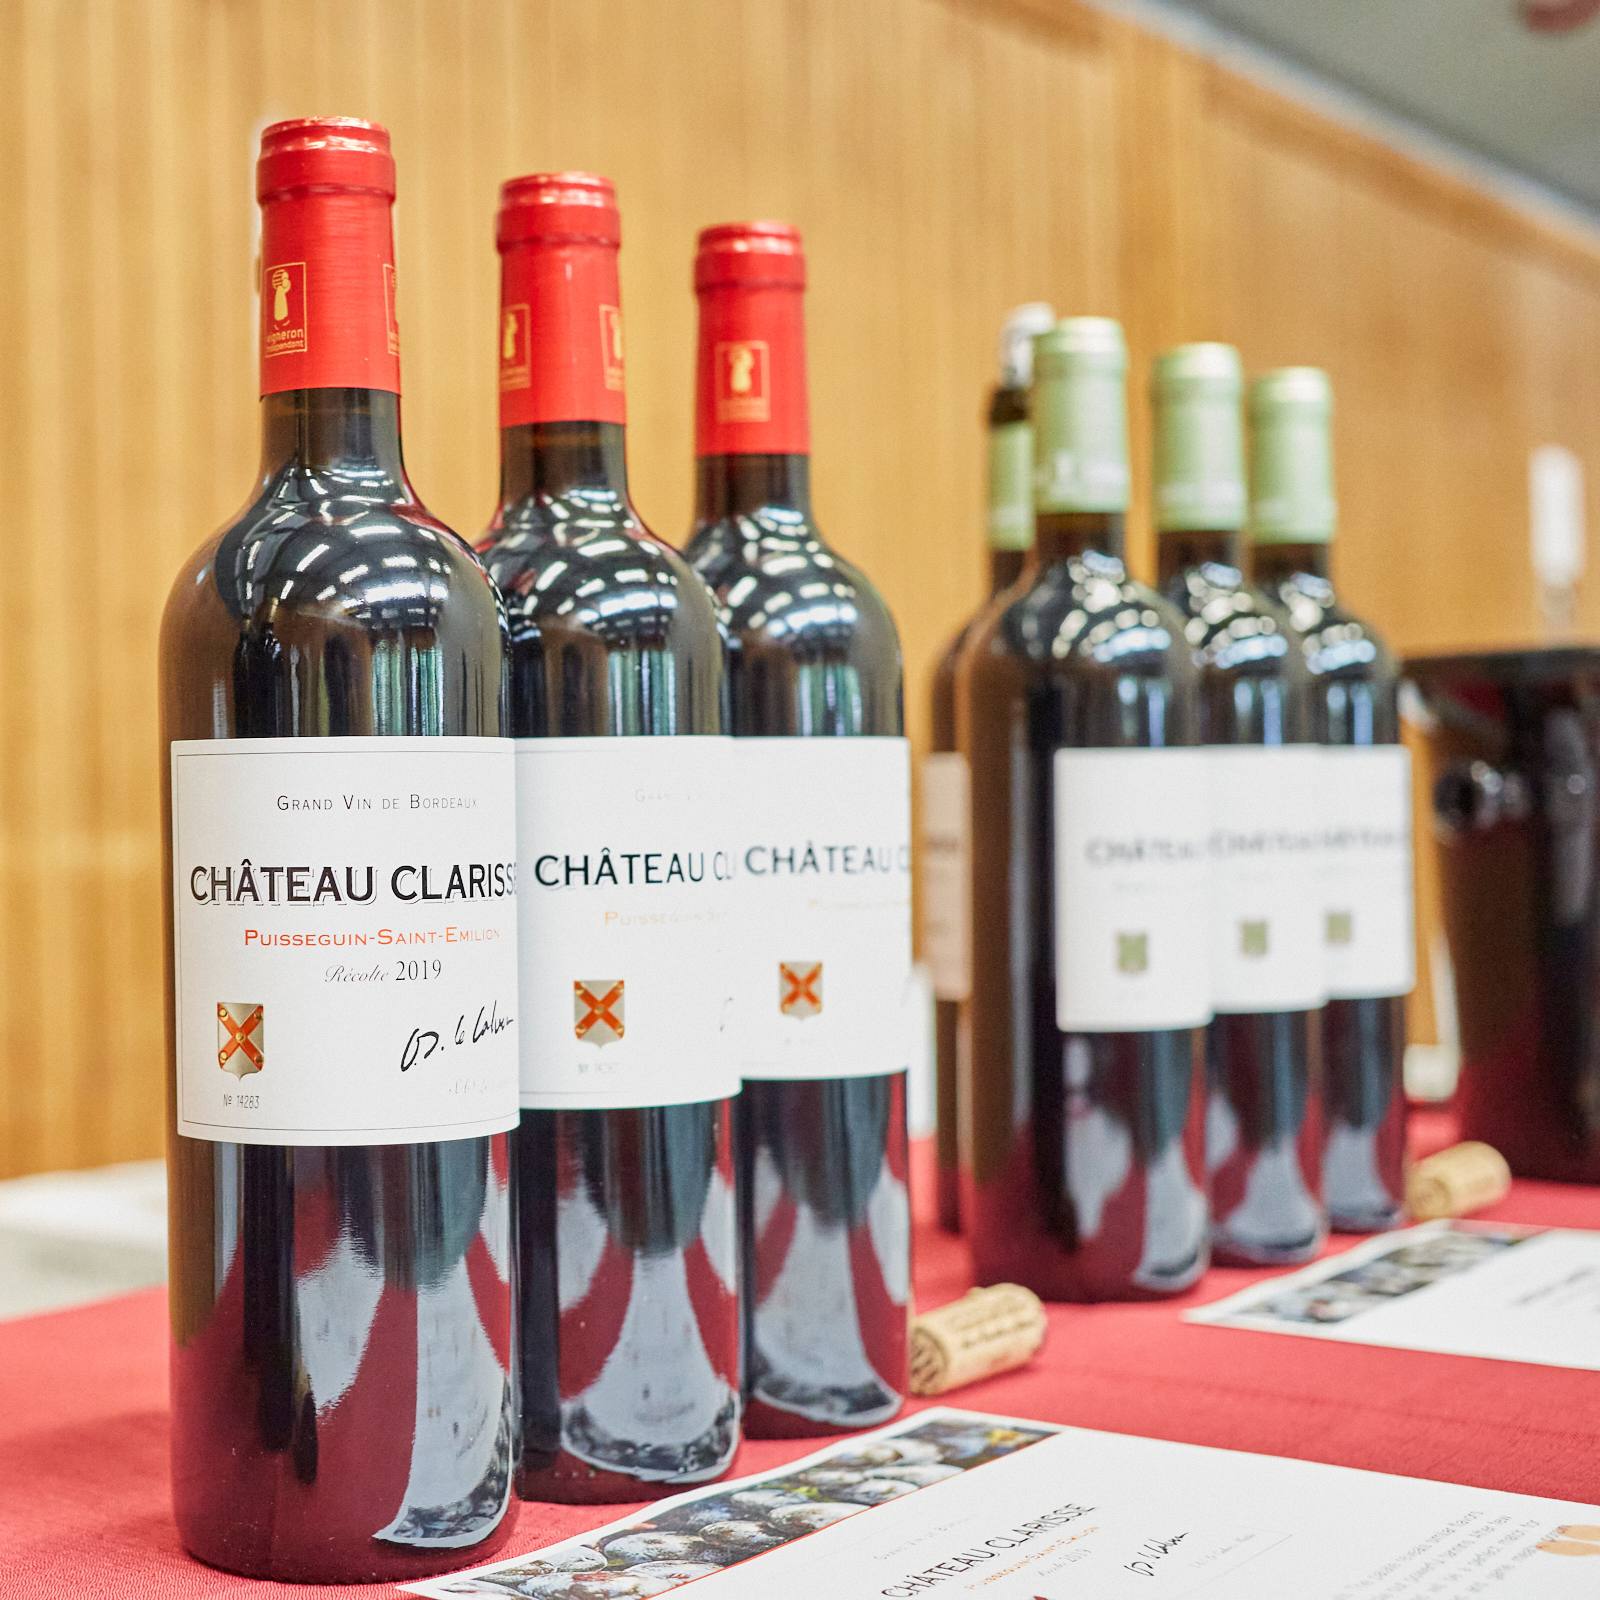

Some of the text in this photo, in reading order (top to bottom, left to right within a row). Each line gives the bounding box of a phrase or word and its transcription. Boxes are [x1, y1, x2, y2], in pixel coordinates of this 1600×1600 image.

[276, 793, 479, 811] GRAND VIN DE BORDEAUX
[534, 847, 705, 890] CHÂTEAU
[744, 840, 892, 876] CHÂTEAU
[190, 858, 377, 906] CHÂTEAU
[324, 959, 443, 984] Récolte 2019
[984, 1502, 1098, 1550] CLARISSE
